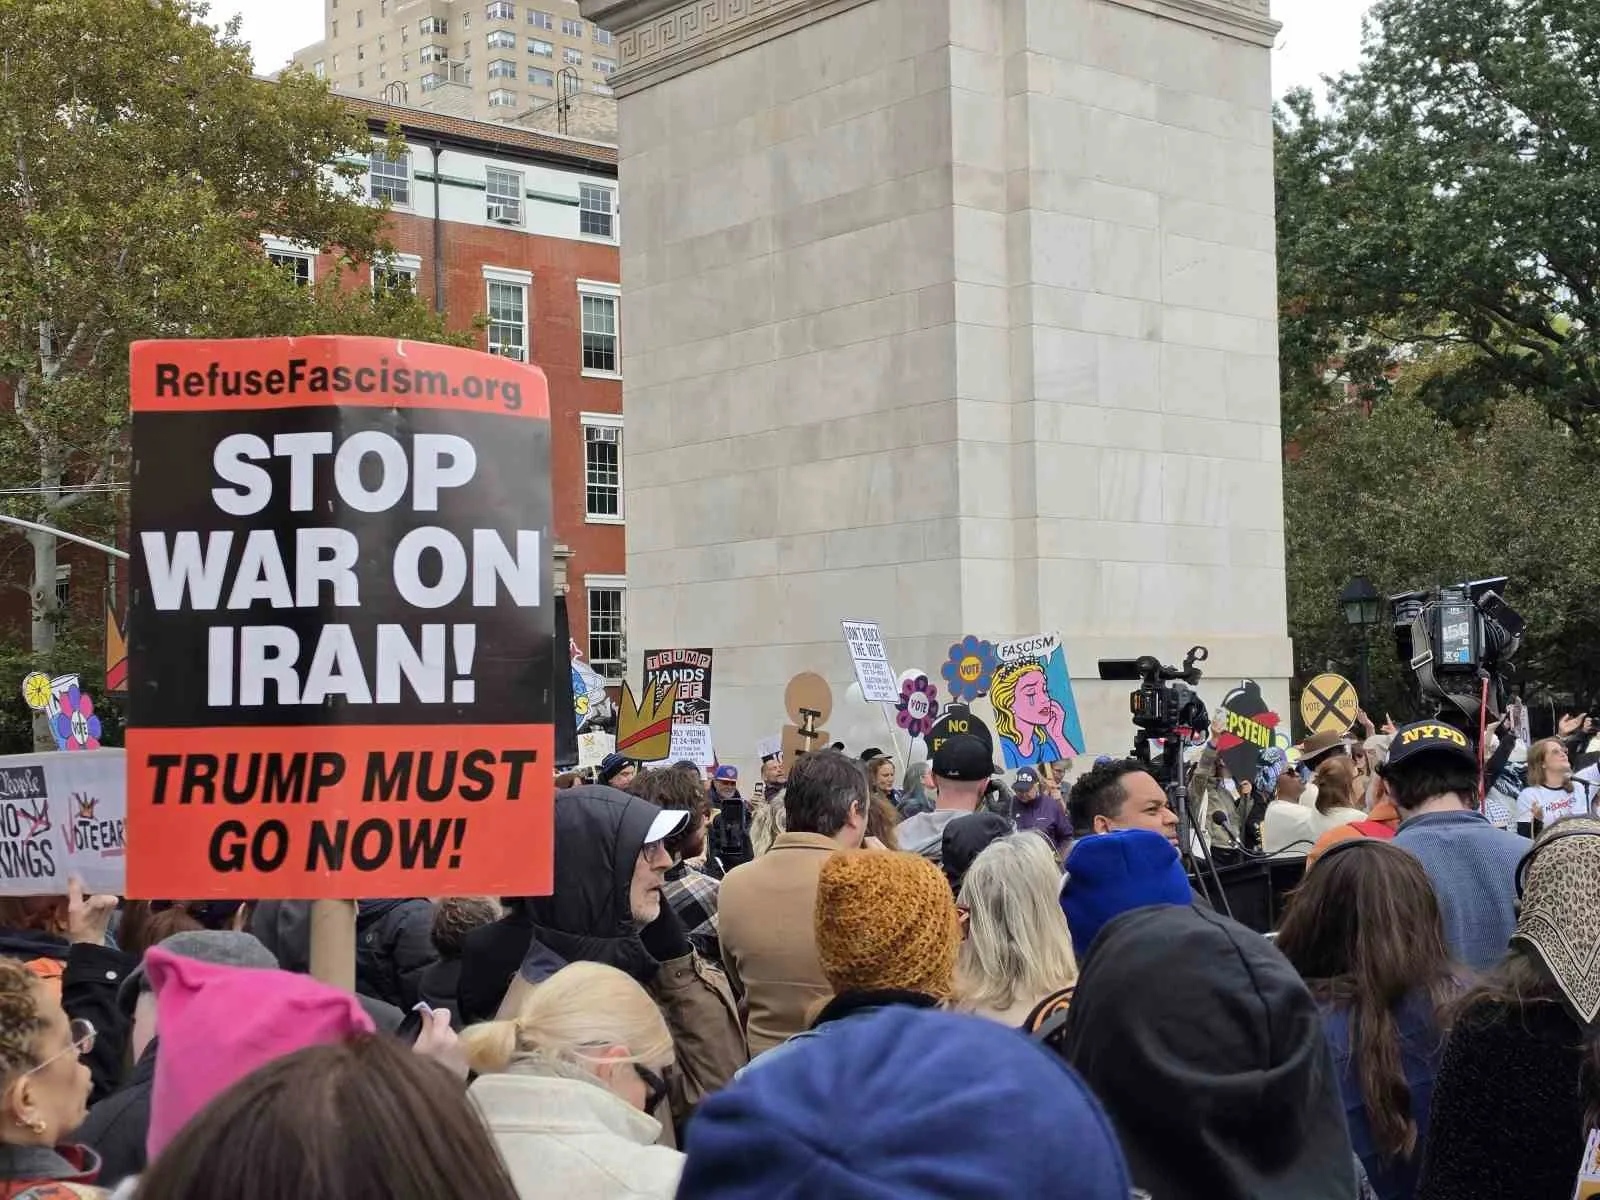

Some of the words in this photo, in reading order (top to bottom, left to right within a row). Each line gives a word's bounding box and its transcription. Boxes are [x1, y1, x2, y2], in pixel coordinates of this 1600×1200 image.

[156, 359, 522, 410] RefuseFascism.org
[211, 430, 477, 516] STOP
[140, 527, 361, 610] WAR
[393, 526, 541, 609] ON
[852, 642, 867, 657] THE
[866, 643, 884, 658] VOTE
[1002, 636, 1054, 657] FASCISM
[207, 623, 477, 707] IRAN!
[649, 651, 709, 669] TRUMP
[961, 663, 979, 674] VOTE
[648, 668, 704, 684] HANDS
[911, 699, 928, 713] VOTE
[948, 720, 968, 733] NO
[1226, 711, 1271, 748] EPSTEIN
[1402, 725, 1467, 747] NYPD
[147, 752, 346, 805] TRUMP
[362, 749, 537, 802] MUST
[208, 819, 289, 873] GO
[305, 817, 467, 873] NOW!
